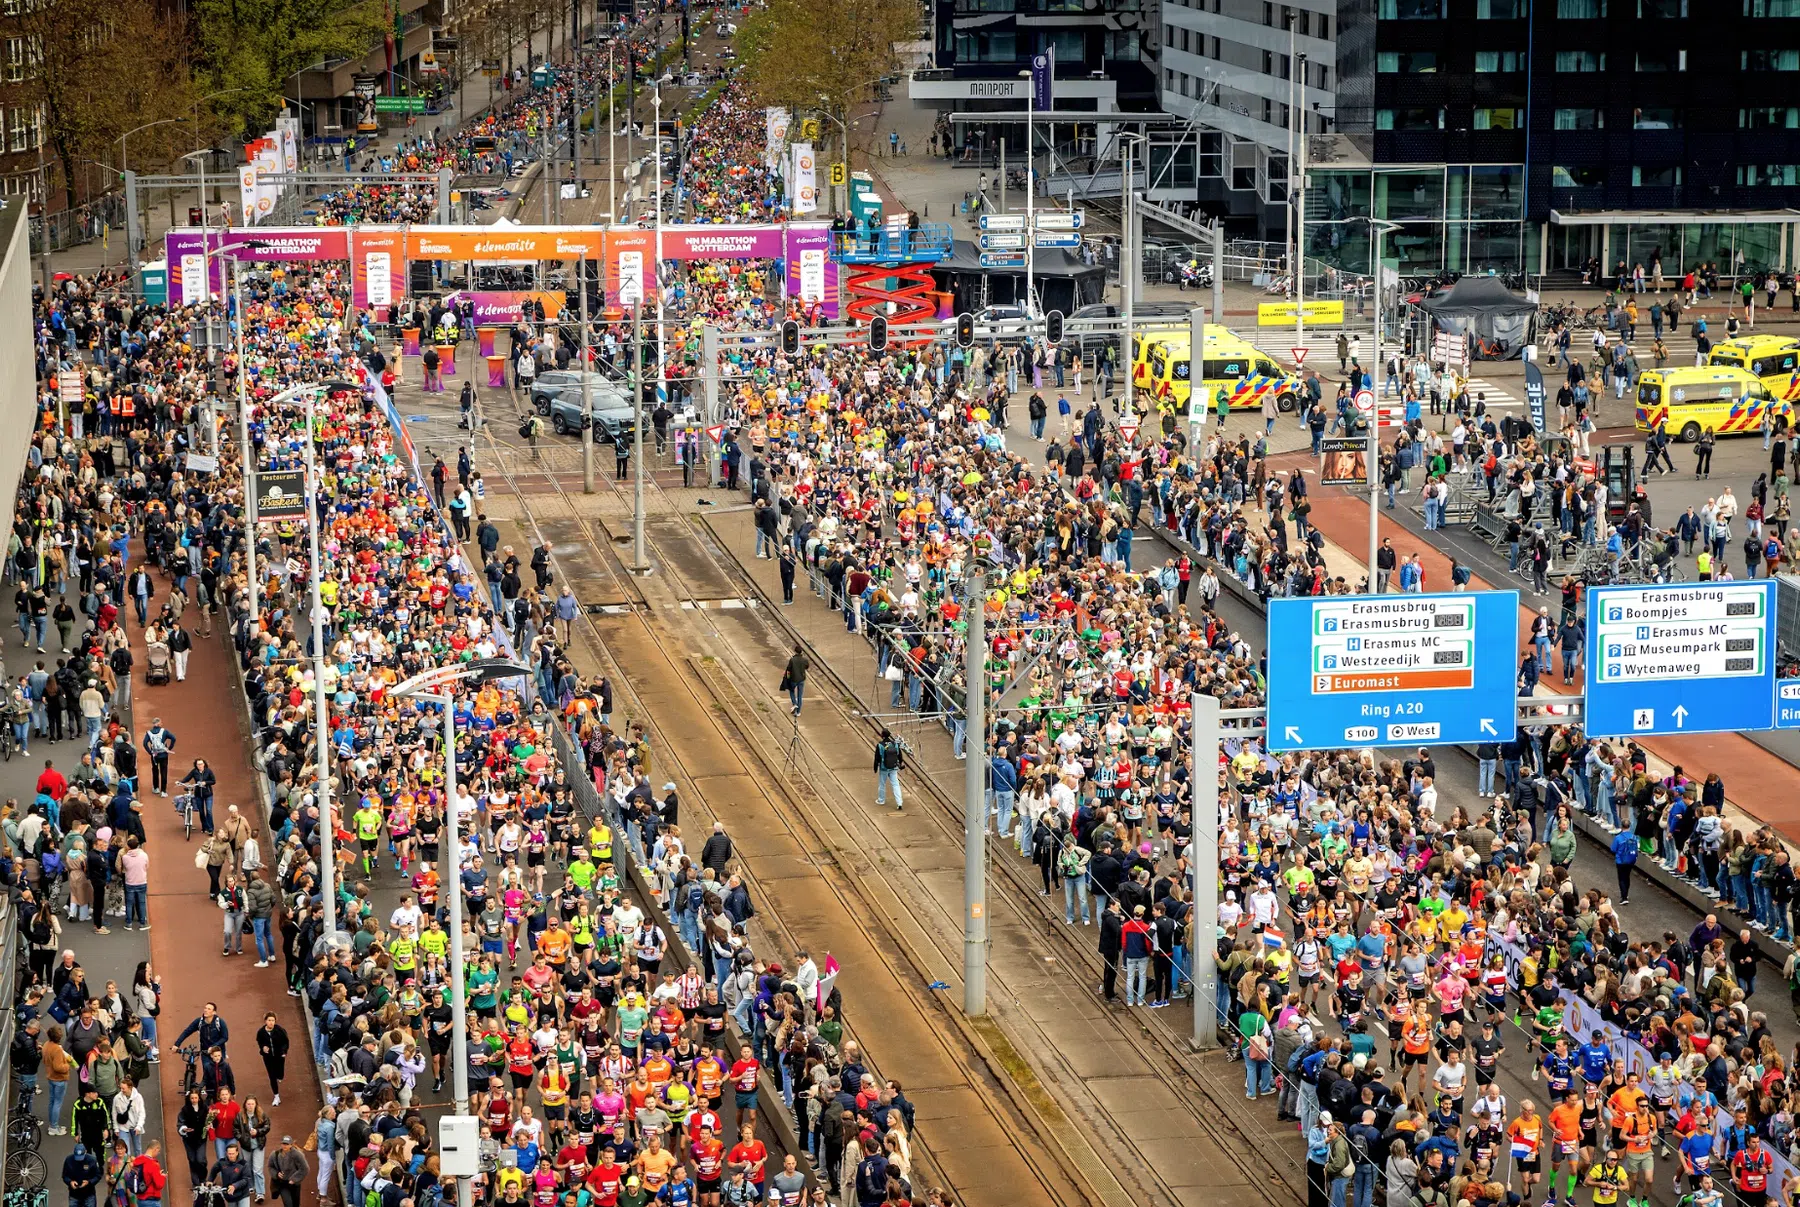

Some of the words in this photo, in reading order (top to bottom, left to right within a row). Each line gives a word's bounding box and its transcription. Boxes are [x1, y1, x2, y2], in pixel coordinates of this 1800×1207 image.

[970, 82, 1014, 95] MAINPORT
[833, 166, 843, 182] B
[474, 239, 535, 253] #demooiste
[701, 236, 756, 245] MARATHON
[255, 246, 316, 254] ROTTERDAM
[691, 244, 752, 252] ROTTERDAM
[476, 303, 524, 316] #demooi
[1642, 591, 1724, 603] Erasmusbrug
[1352, 602, 1436, 614] Erasmusbrug
[1626, 607, 1687, 619] Boompjes
[1342, 617, 1430, 630] Erasmusbrug
[1653, 627, 1704, 638] Erasmus
[1709, 625, 1728, 635] MC
[1364, 638, 1416, 650] Erasmus
[1422, 637, 1440, 647] MC
[1640, 642, 1721, 655] Museumpark
[1341, 654, 1420, 667] Westzeedijk
[1625, 663, 1700, 676] Wytemaweg
[1335, 676, 1400, 689] Euromast
[1784, 688, 1789, 696] S
[1361, 704, 1390, 717] Ring
[1395, 703, 1424, 715] A20
[1781, 708, 1800, 720] Rin
[1356, 729, 1375, 737] 100
[1407, 726, 1436, 736] West
